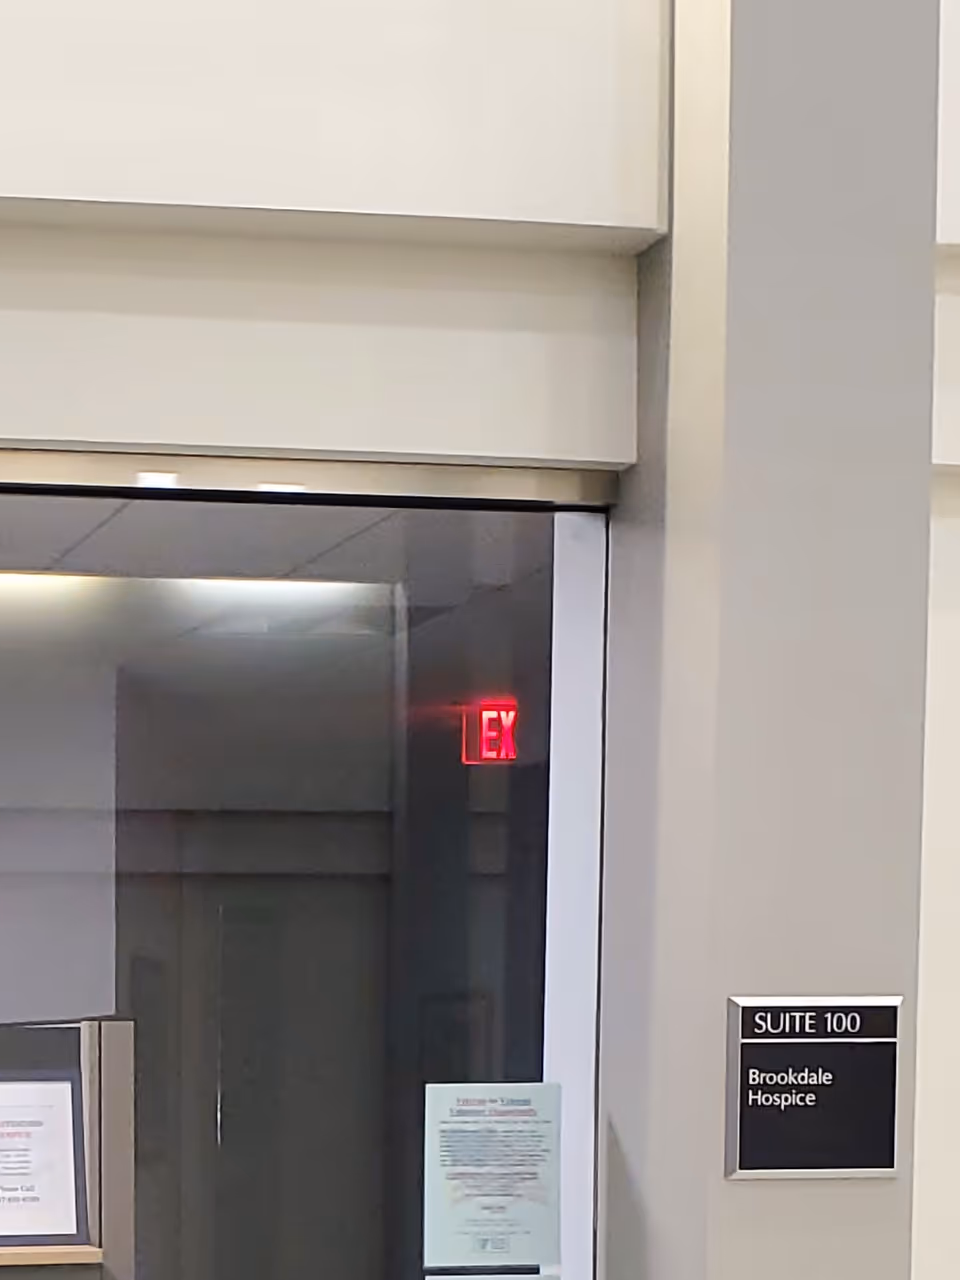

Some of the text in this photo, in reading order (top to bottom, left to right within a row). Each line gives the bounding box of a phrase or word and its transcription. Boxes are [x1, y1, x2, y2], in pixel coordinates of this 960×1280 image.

[753, 1012, 861, 1034] SUITE 100
[748, 1067, 833, 1085] Brookdale
[748, 1089, 817, 1111] Hospice
